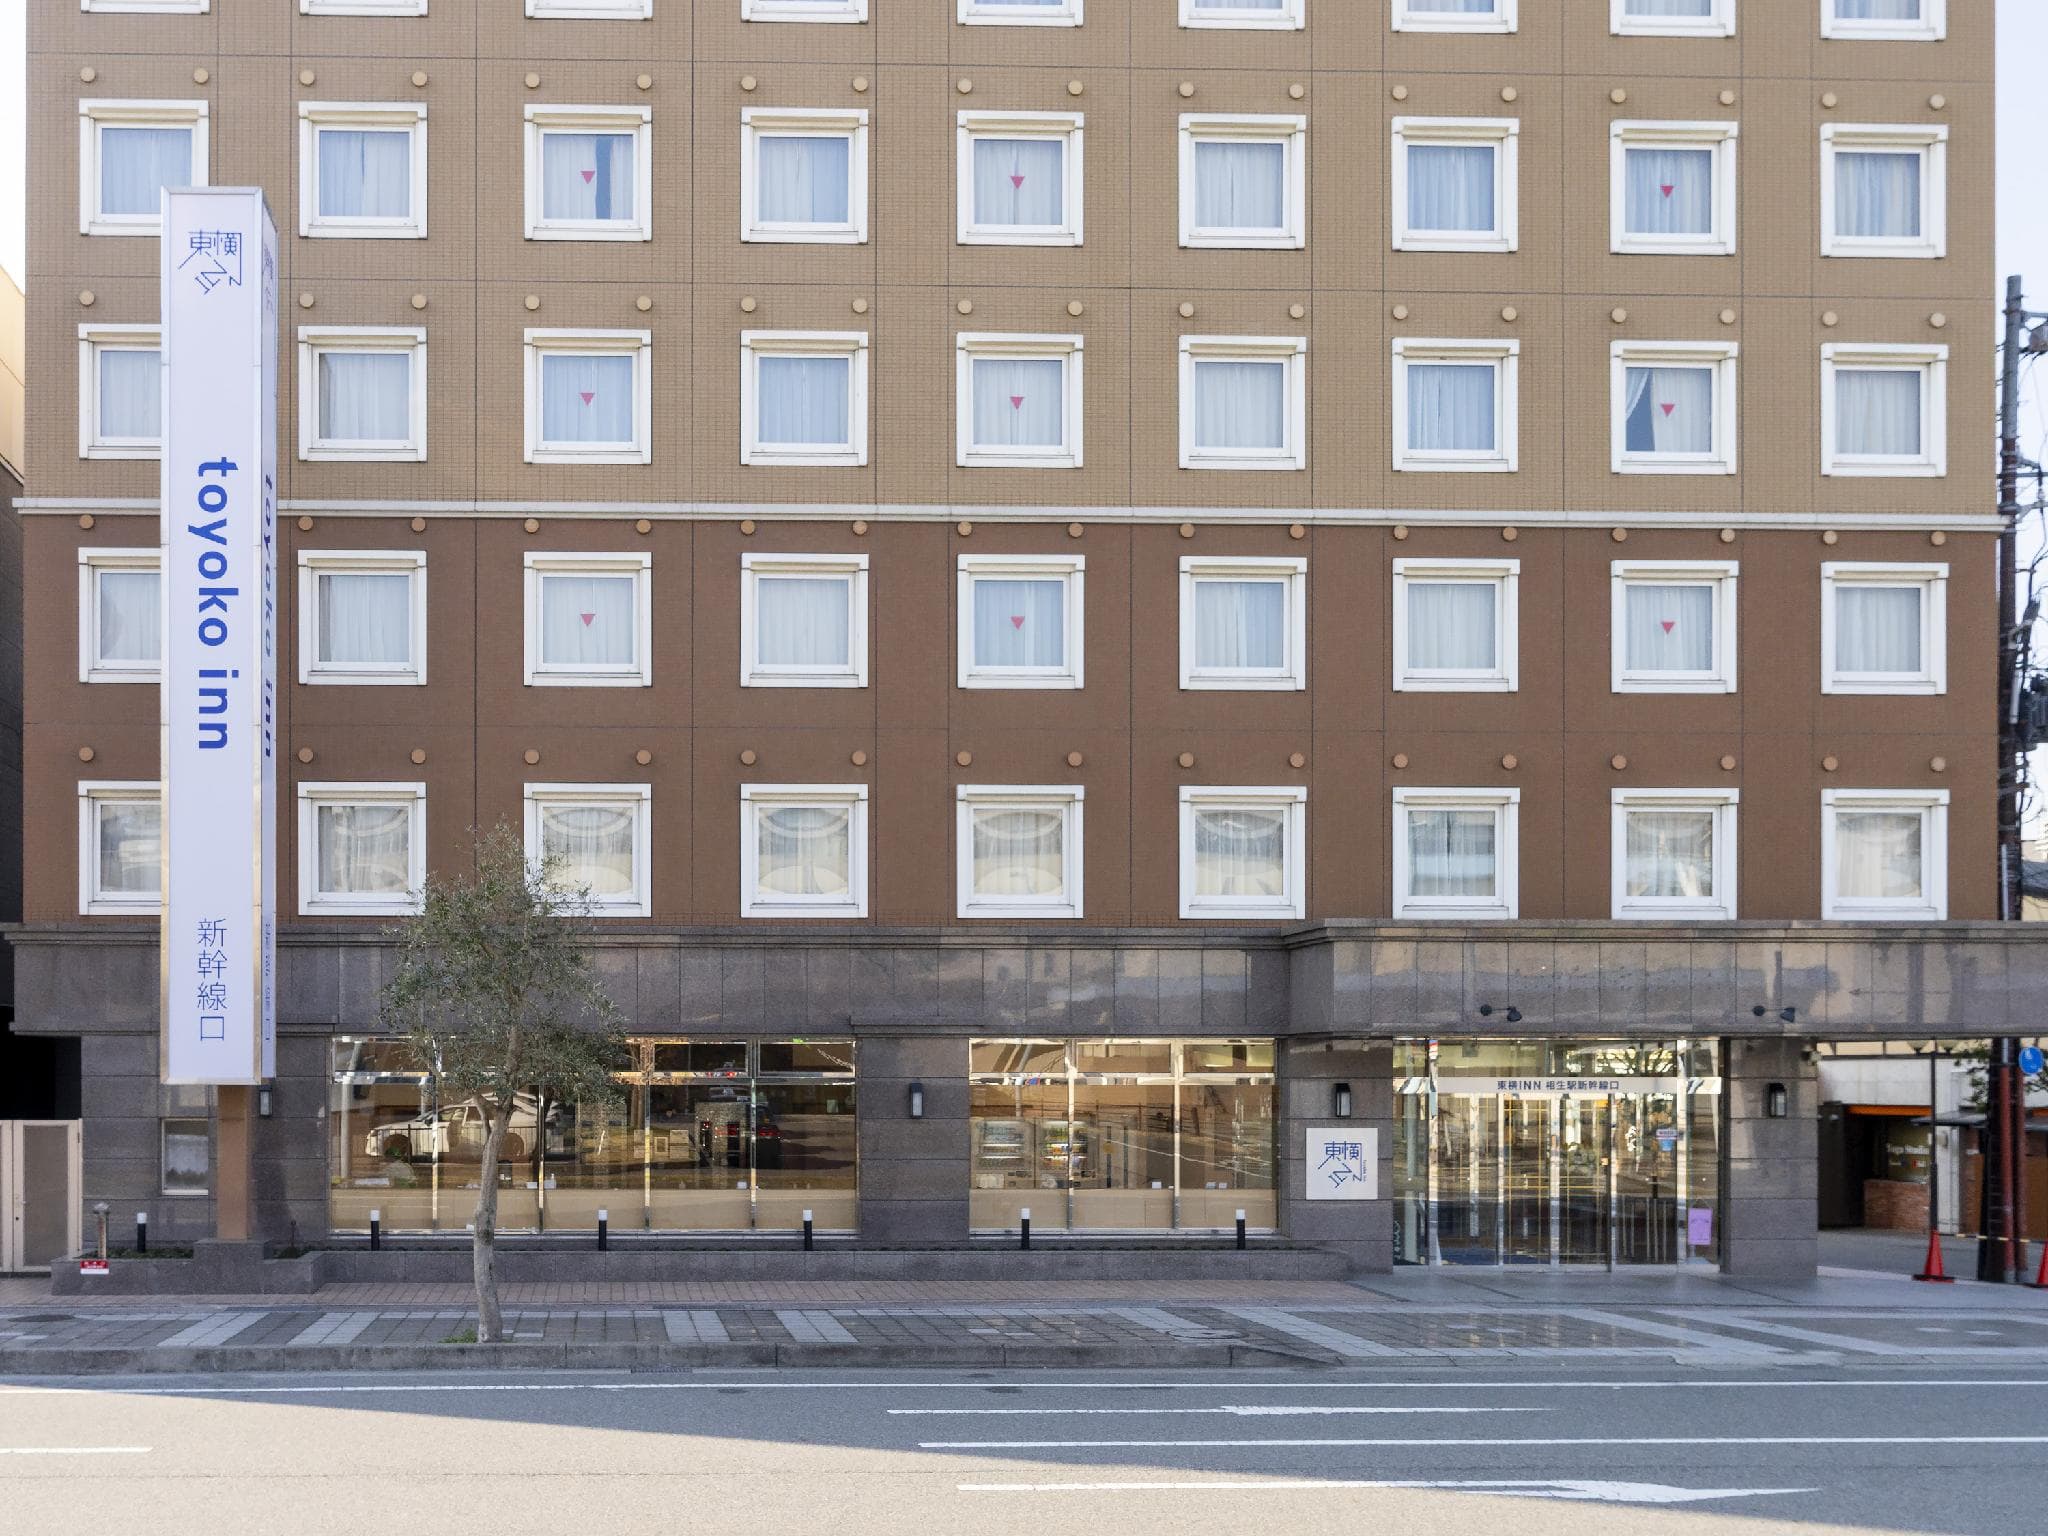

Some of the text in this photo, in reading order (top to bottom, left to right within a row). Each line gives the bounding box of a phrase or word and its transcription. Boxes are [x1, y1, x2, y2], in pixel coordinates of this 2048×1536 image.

[188, 457, 240, 749] toyoko inn
[197, 918, 228, 1042] 新幹線口
[1497, 1080, 1542, 1090] 東横INN
